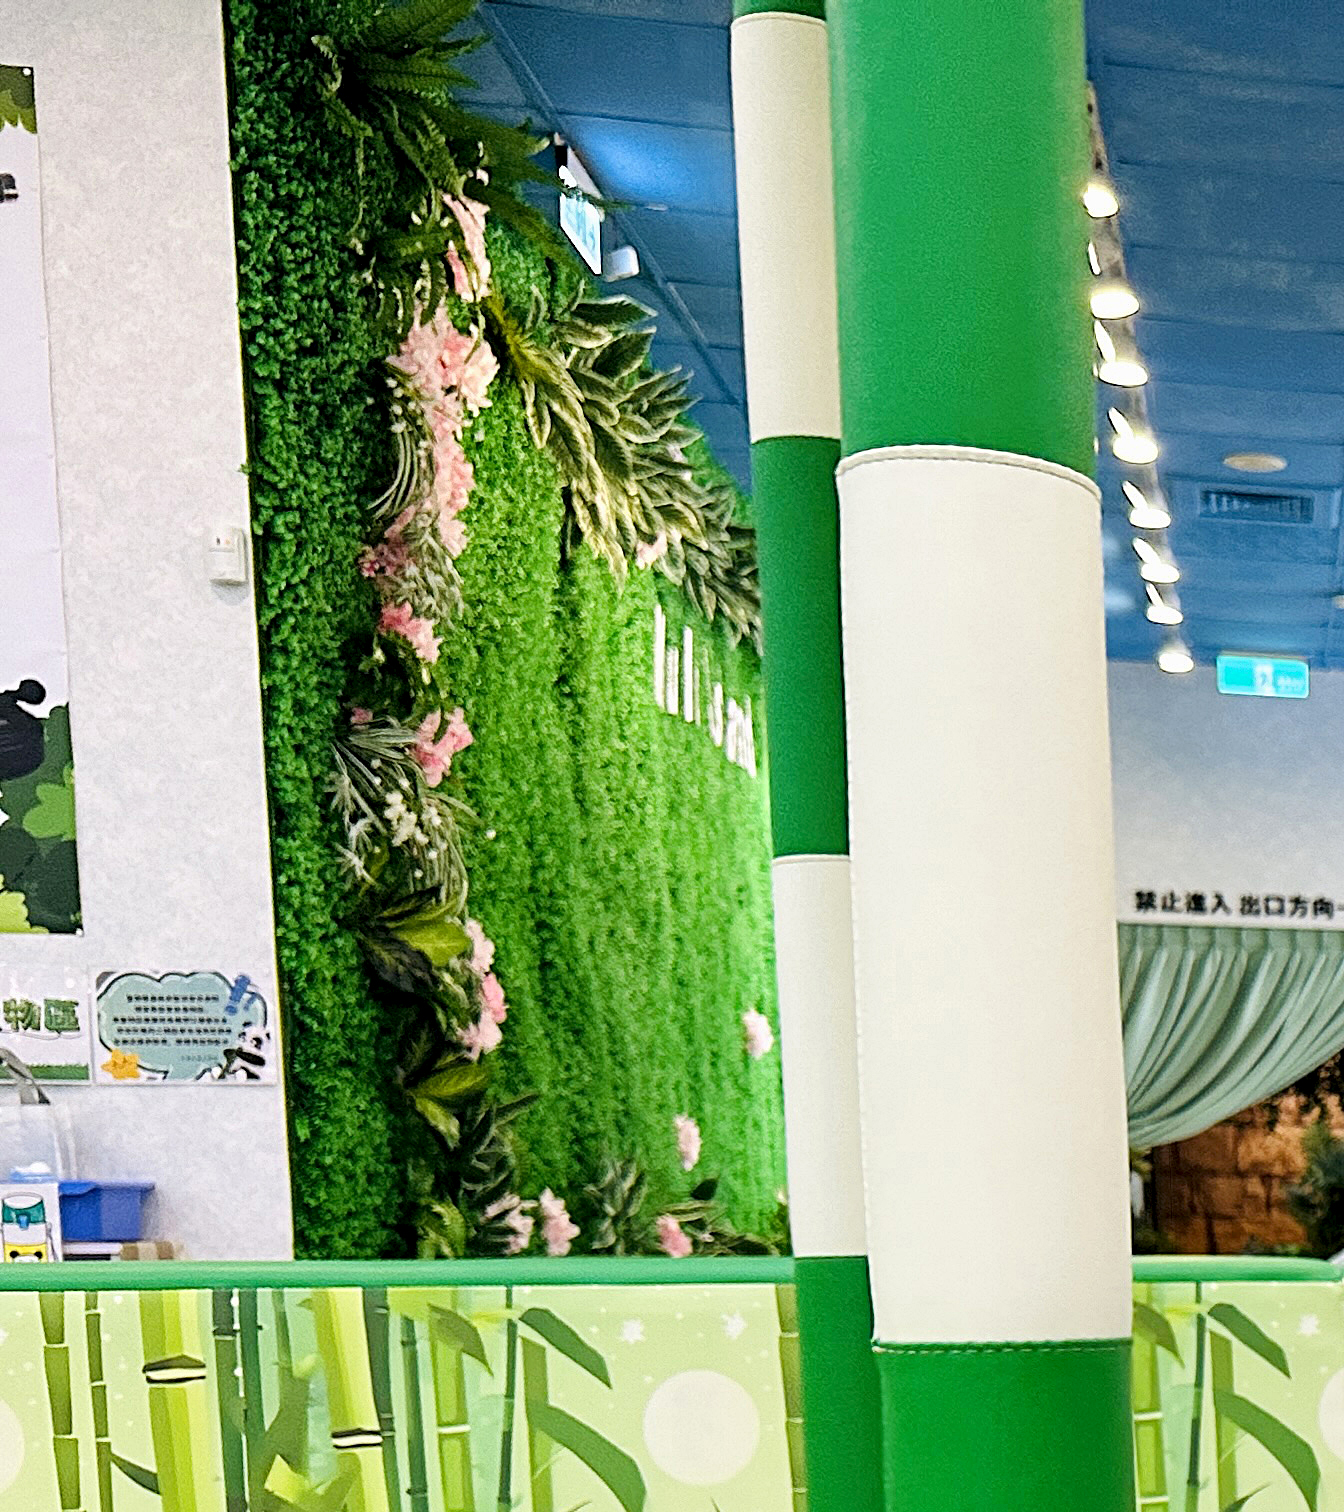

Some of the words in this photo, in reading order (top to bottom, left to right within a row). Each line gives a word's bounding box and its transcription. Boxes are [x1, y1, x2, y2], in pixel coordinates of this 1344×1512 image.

[1135, 890, 1232, 916] 禁止進入
[1239, 895, 1334, 920] 出口方向
[0, 997, 81, 1033] 物區
